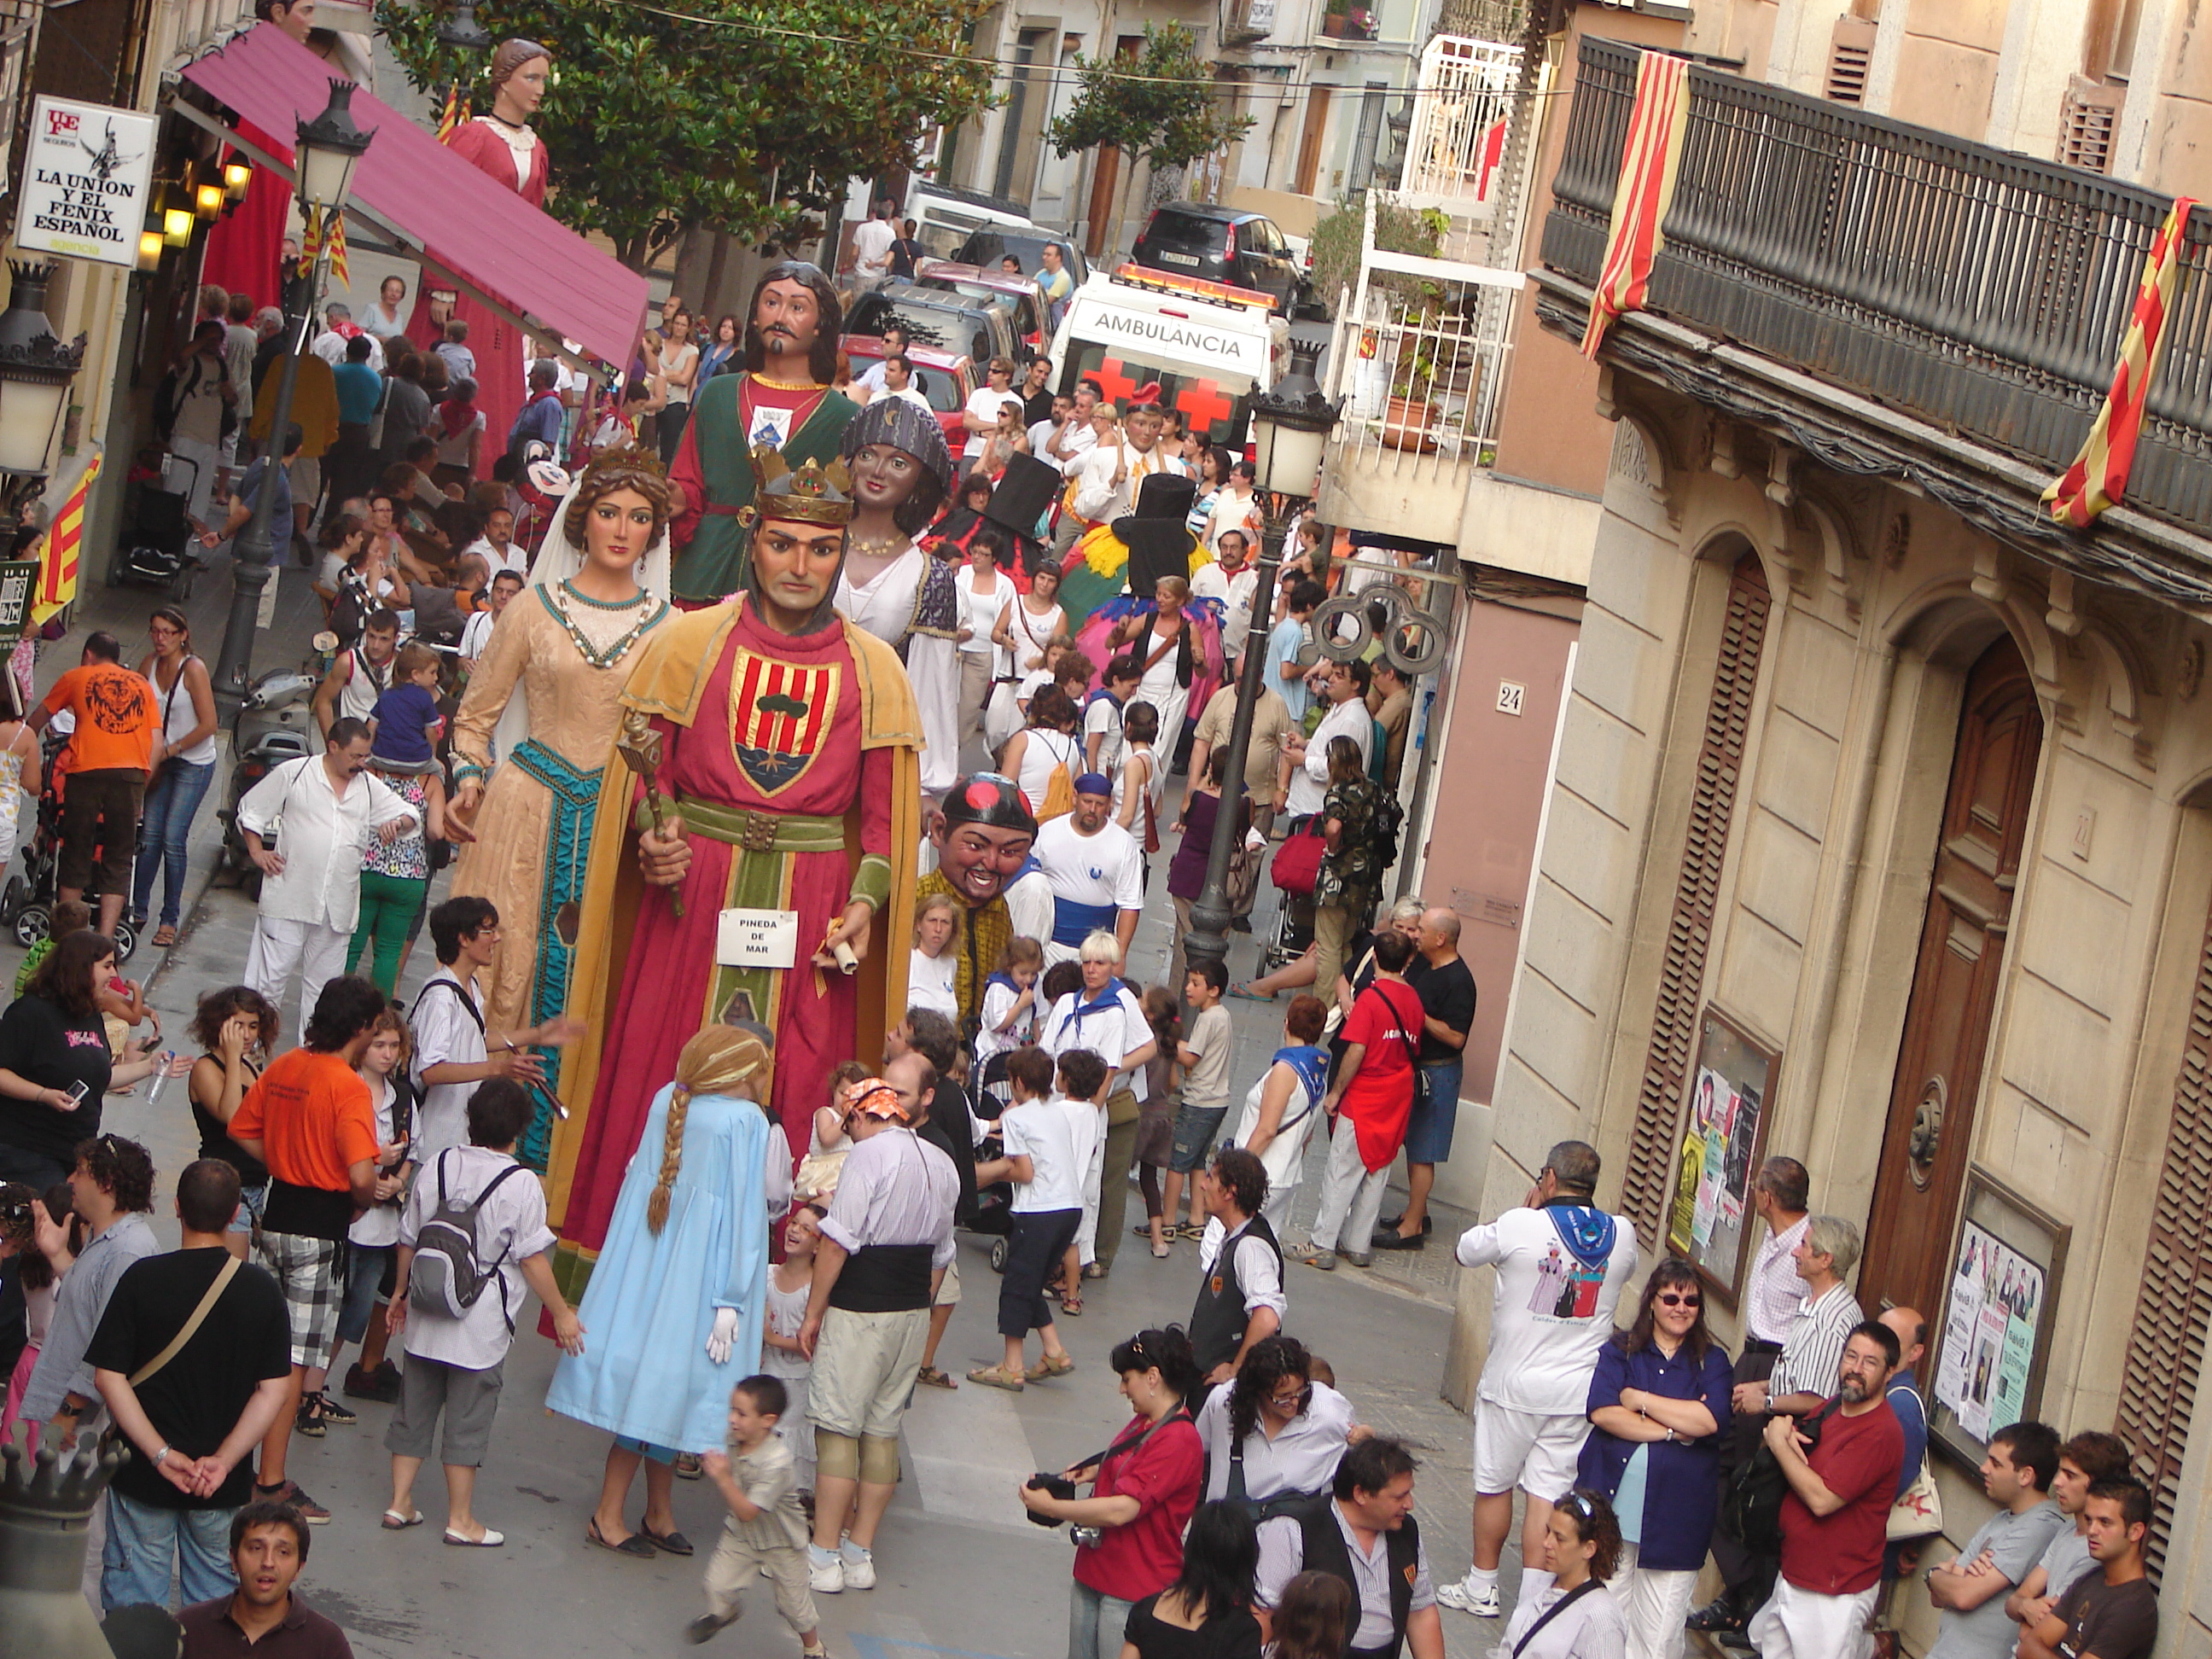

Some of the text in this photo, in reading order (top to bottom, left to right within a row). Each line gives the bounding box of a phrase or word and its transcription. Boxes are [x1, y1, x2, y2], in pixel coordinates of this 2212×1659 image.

[36, 169, 135, 197] LA UNION
[61, 189, 106, 207] Y EL
[49, 201, 114, 224] FENIX
[33, 215, 124, 242] ESPAÑOL
[49, 237, 100, 256] agencia
[1095, 313, 1240, 358] AMBULÀNCIA
[1499, 686, 1521, 709] 24
[739, 919, 777, 928] PINEDA
[746, 945, 768, 953] MAR
